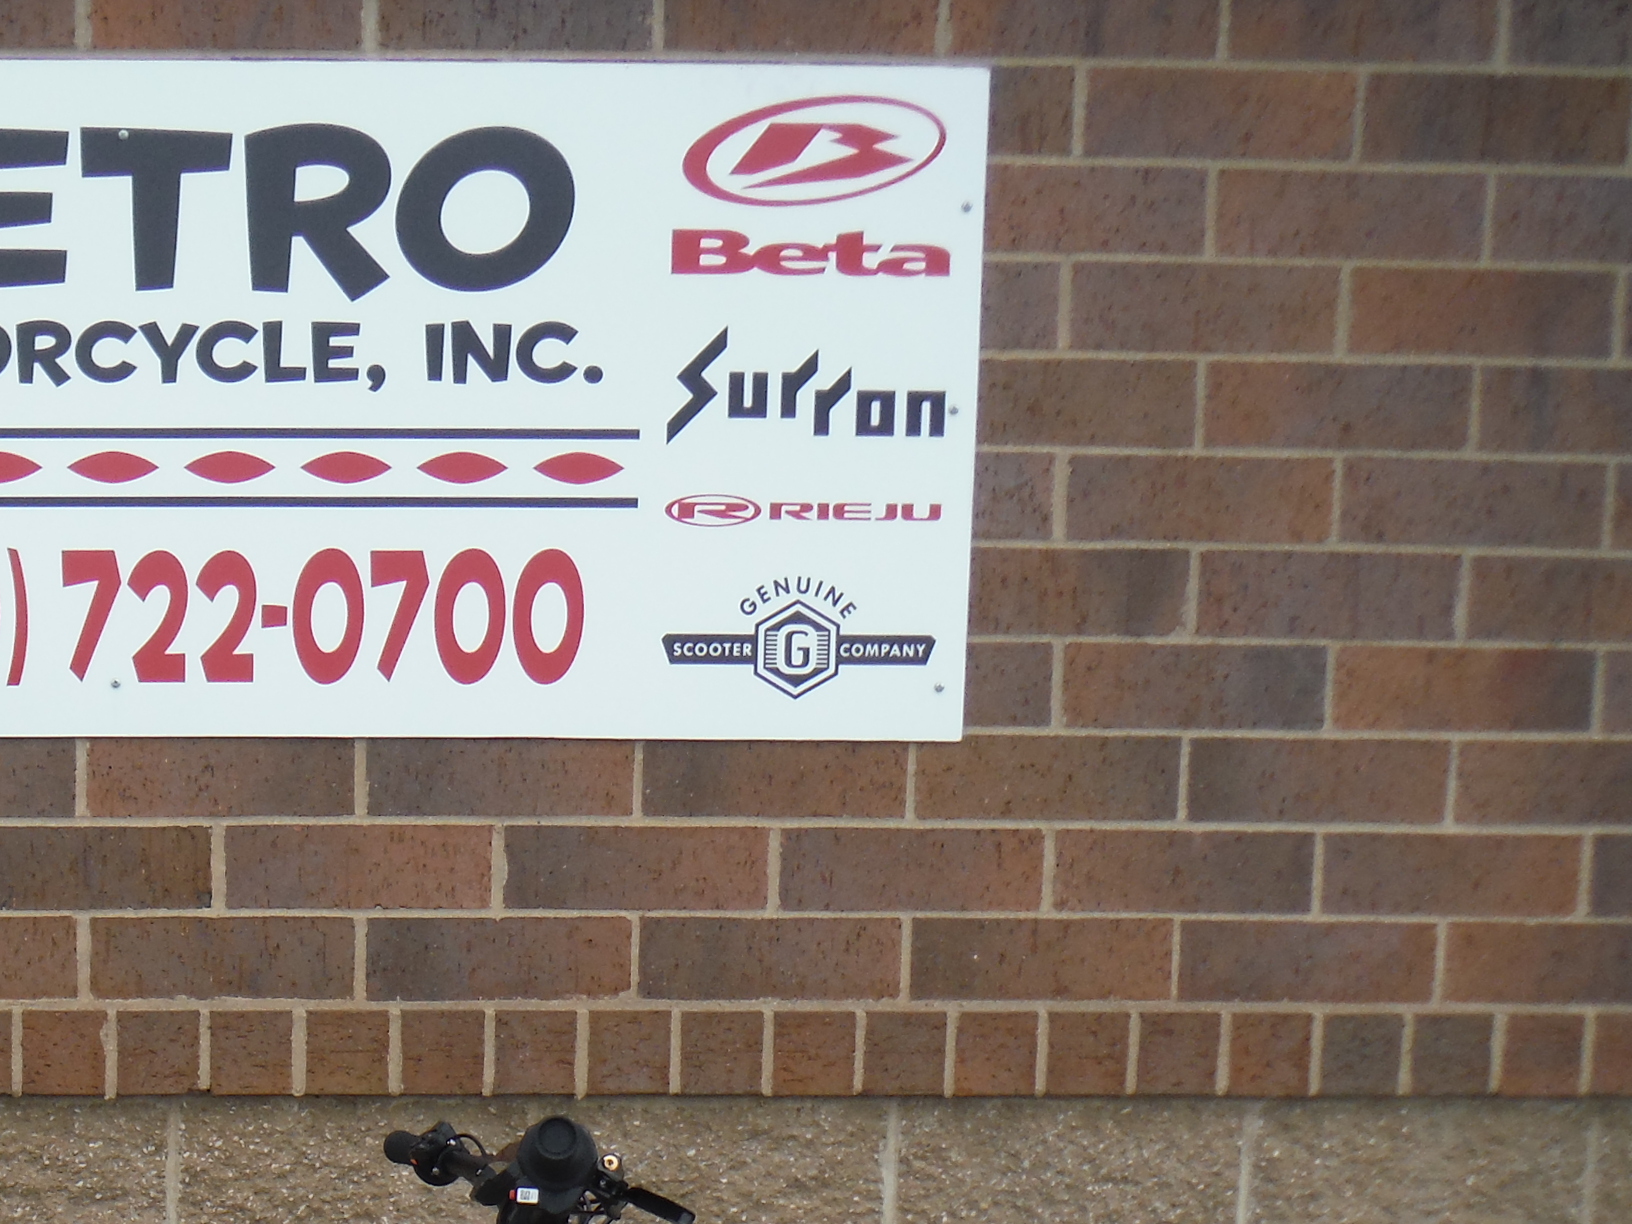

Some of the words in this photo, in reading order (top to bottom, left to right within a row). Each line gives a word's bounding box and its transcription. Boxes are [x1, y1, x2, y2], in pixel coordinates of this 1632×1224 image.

[671, 229, 950, 276] Beta
[426, 322, 604, 385] INC.
[666, 325, 947, 444] Surron
[769, 502, 942, 521] RIEJU
[62, 548, 585, 686] 722-0700
[739, 575, 857, 619] GENUINE
[672, 642, 753, 658] SCOOTER
[784, 630, 811, 669] G
[839, 642, 927, 659] COMPANY
